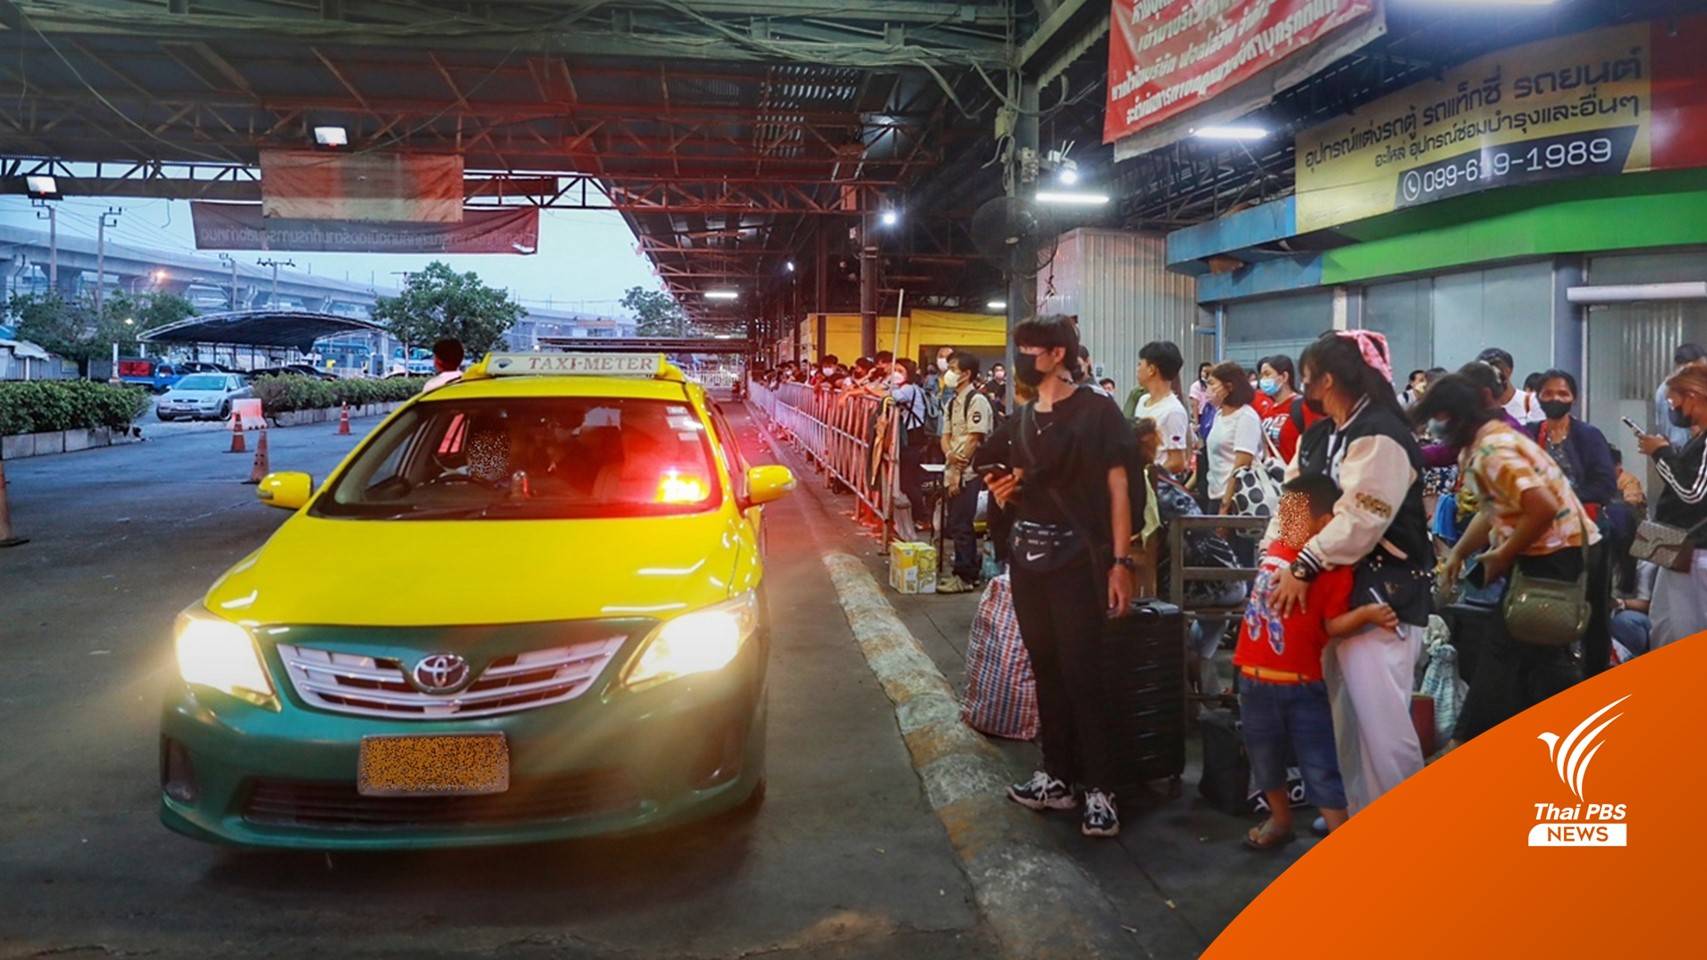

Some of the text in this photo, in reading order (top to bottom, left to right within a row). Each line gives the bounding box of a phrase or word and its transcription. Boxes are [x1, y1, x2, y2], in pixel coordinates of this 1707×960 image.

[1305, 46, 1643, 173] อุปกรณ์แต่งรถตู้ รถแท็กซี่ รถยนต์
[1375, 140, 1406, 167] อะไหล่
[528, 356, 653, 371] TAXI-METER
